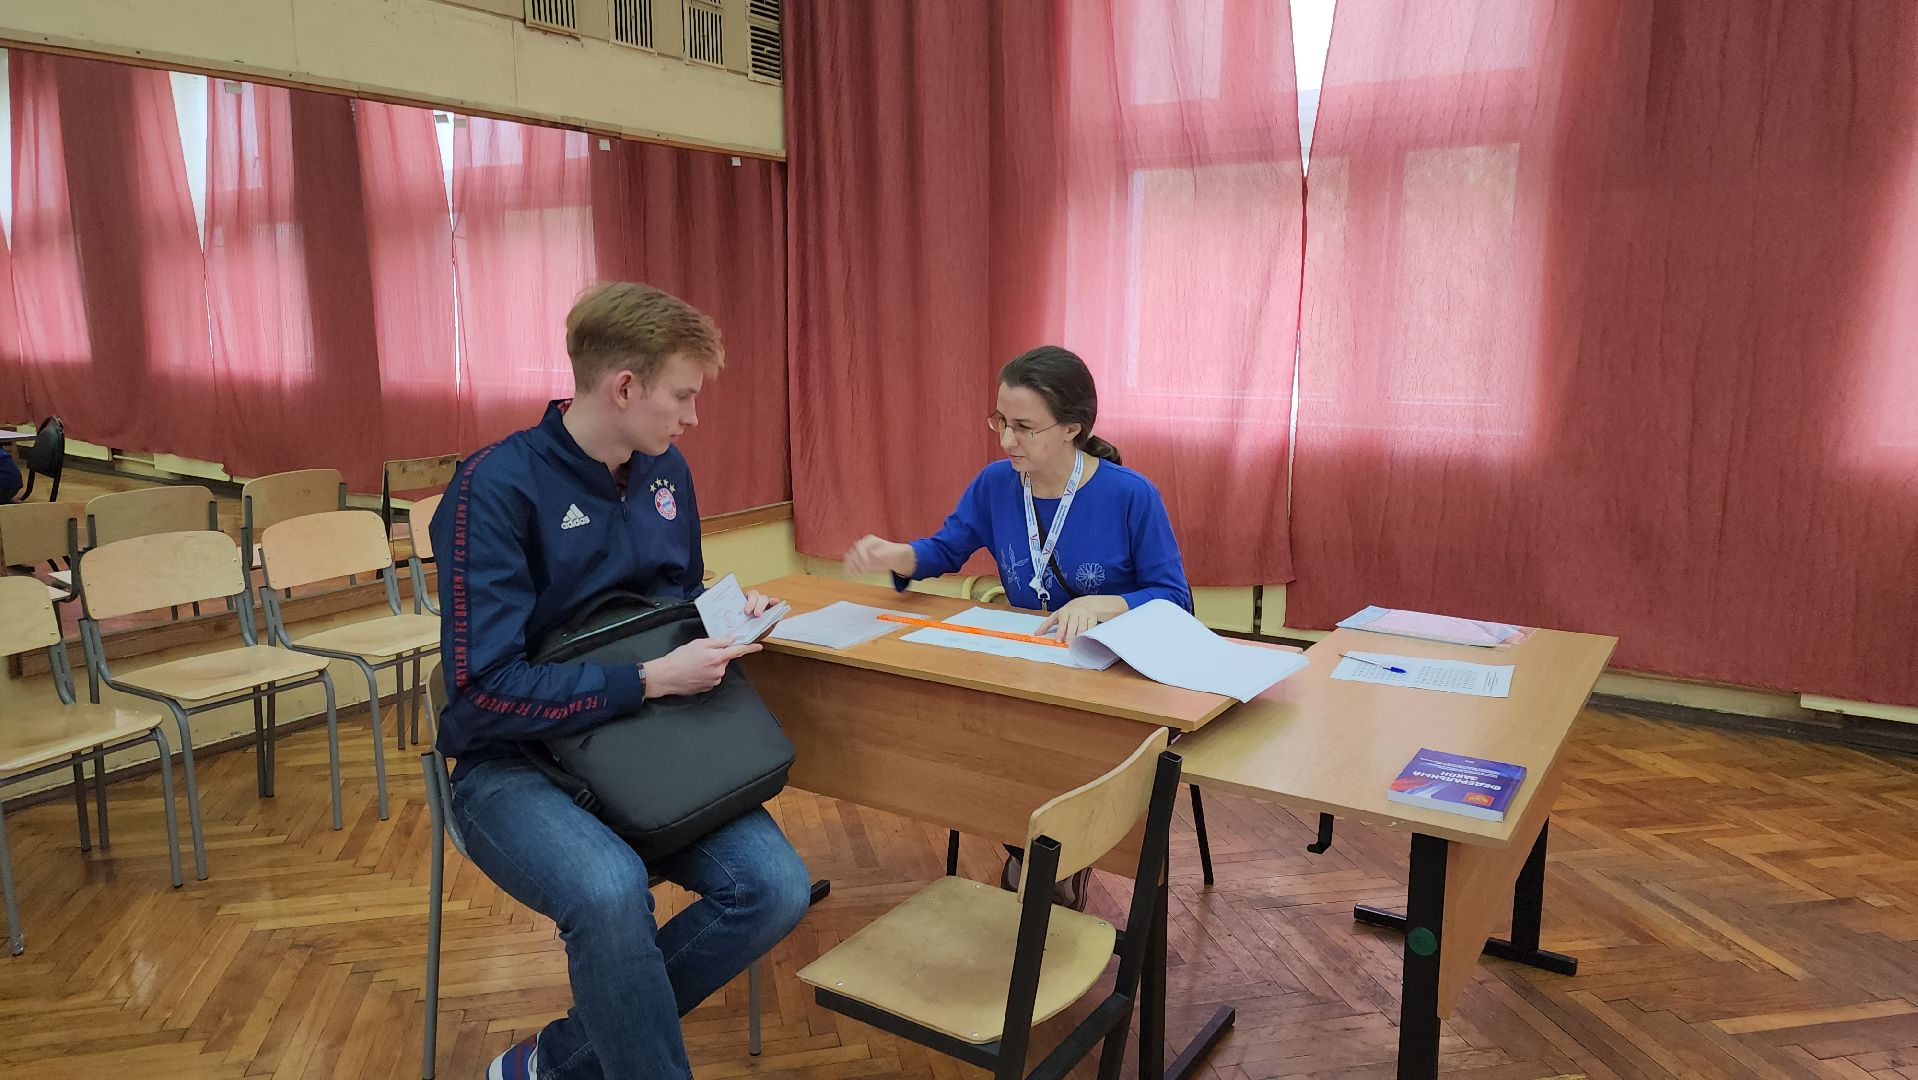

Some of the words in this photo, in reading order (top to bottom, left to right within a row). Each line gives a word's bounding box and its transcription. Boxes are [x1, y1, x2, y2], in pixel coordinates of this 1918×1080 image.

[455, 504, 467, 546] BAYERN
[561, 516, 590, 529] adidas
[454, 550, 466, 562] FC
[454, 576, 467, 616] BAYERN
[455, 620, 467, 633] FC
[585, 696, 598, 709] FC
[516, 703, 531, 716] FC
[1413, 771, 1501, 790] ФЕДЕРАЛЬНЫЙ
[1440, 771, 1479, 781] ЗАКОН
